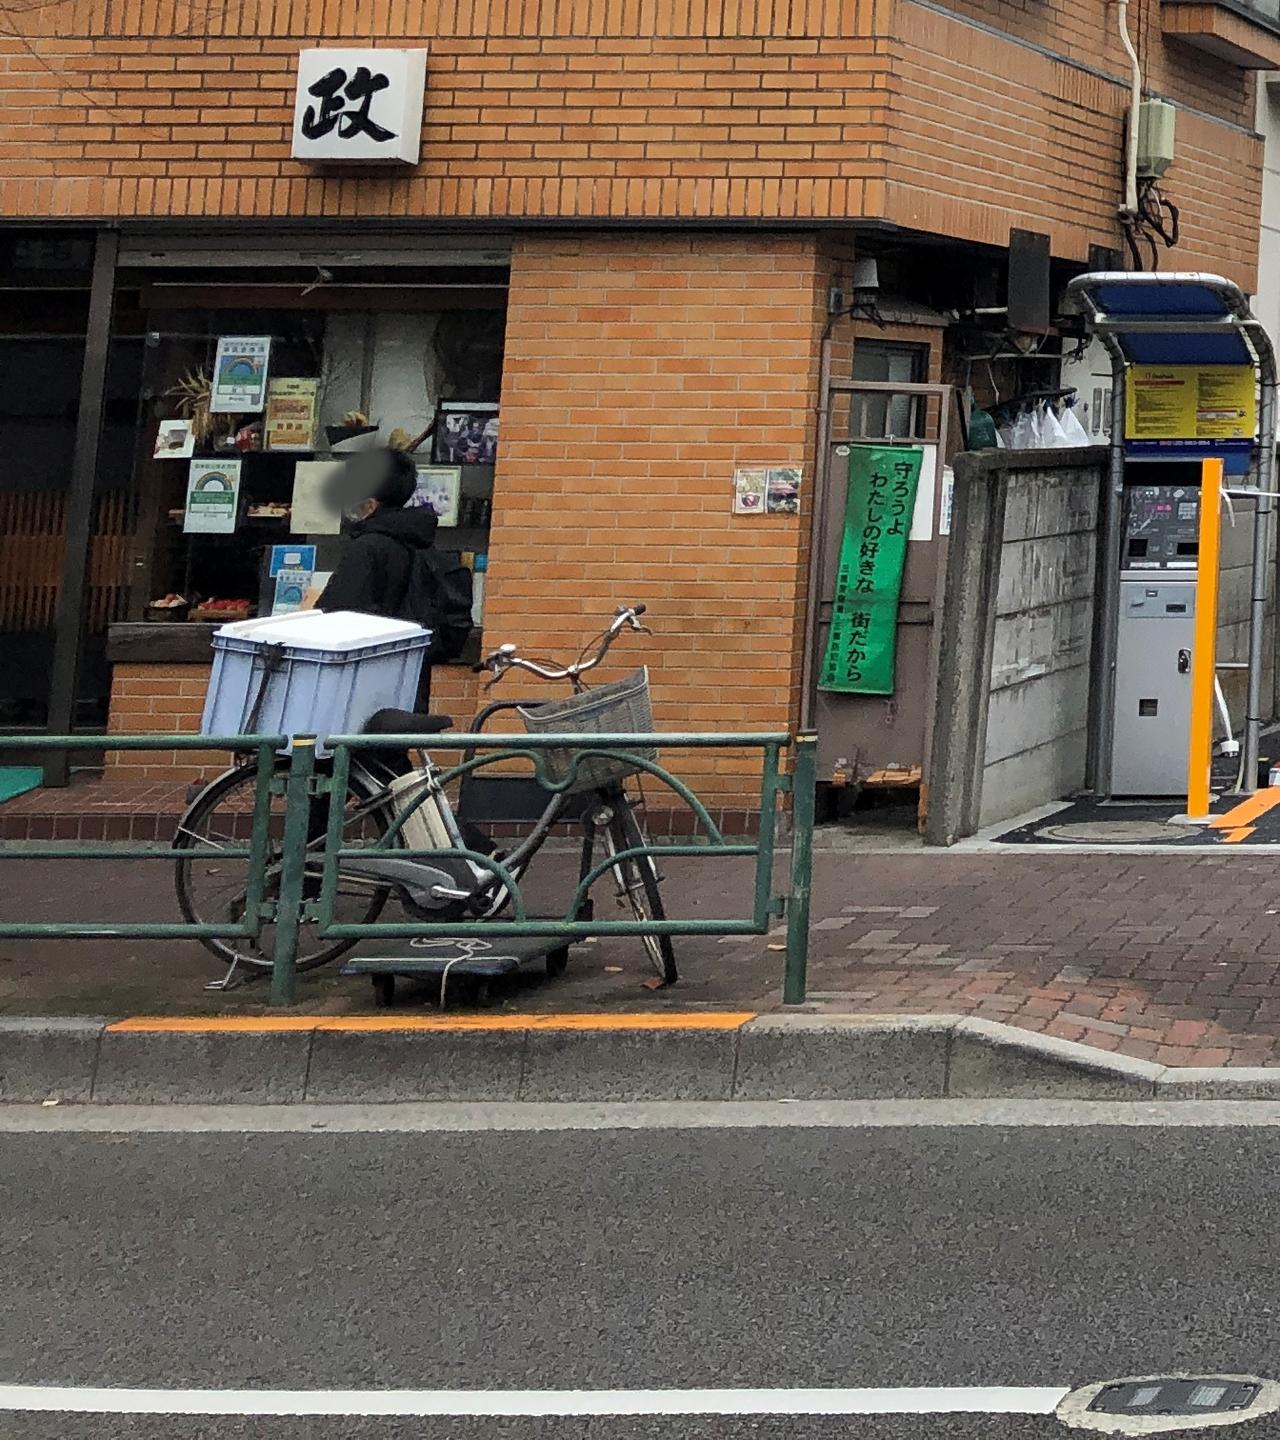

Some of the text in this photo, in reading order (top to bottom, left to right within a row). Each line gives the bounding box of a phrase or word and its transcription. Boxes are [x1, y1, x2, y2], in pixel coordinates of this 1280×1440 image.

[301, 66, 399, 142] 政
[886, 461, 914, 536] 守ろうよ
[846, 472, 888, 683] わたしの好きな 街だから
